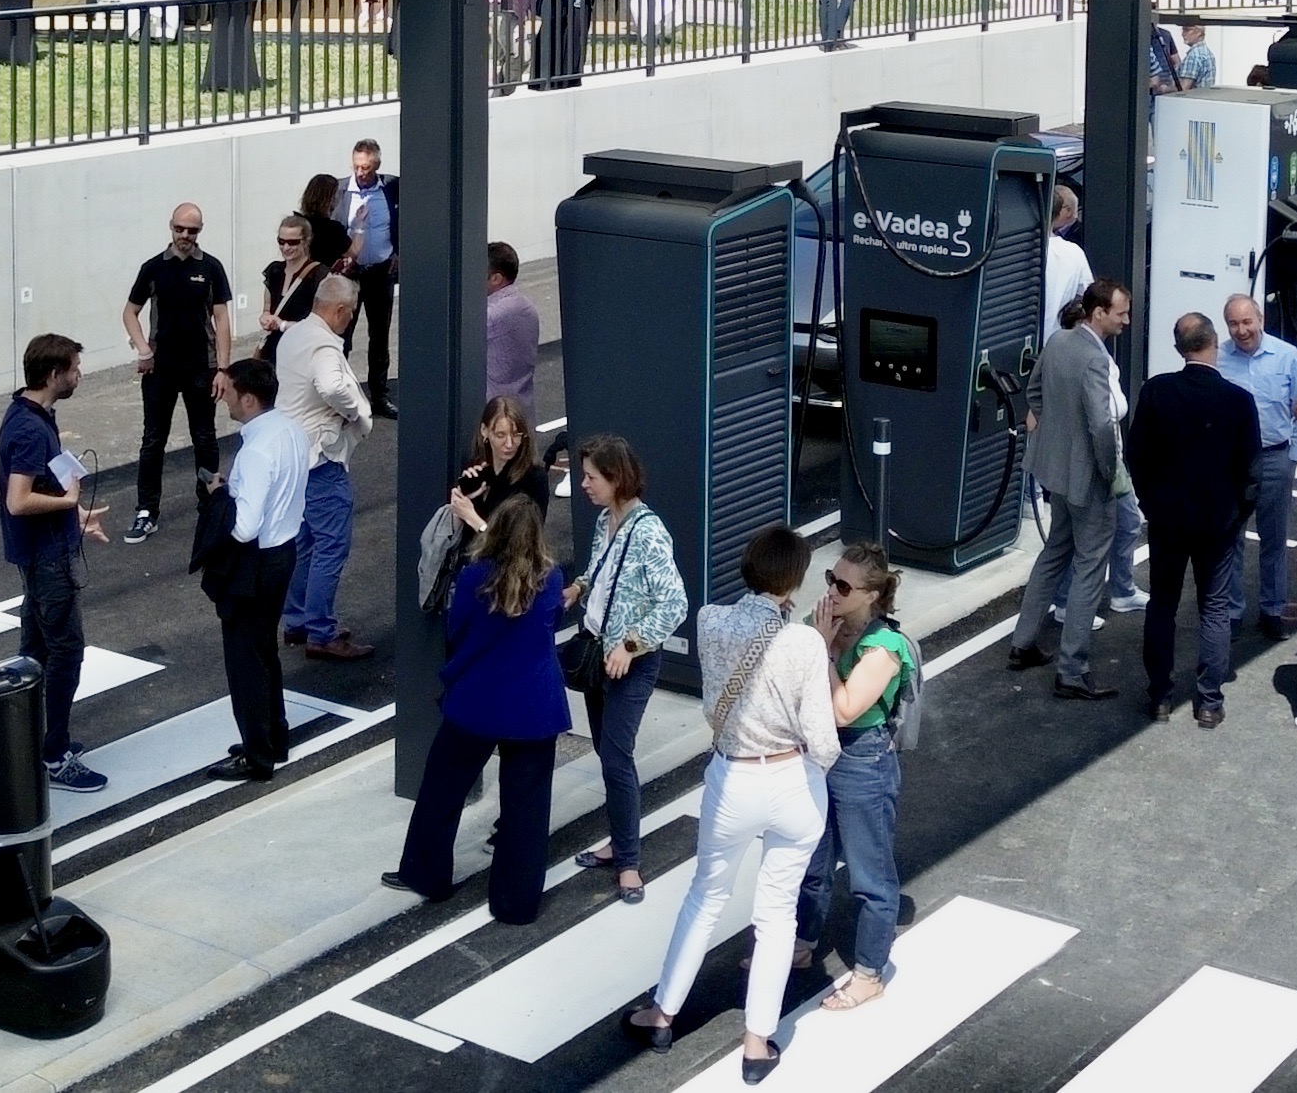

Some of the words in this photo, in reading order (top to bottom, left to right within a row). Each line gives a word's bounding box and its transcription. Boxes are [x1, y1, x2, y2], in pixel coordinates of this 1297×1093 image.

[852, 234, 889, 250] Rechar
[896, 240, 917, 252] ultra
[918, 243, 949, 256] rapide
